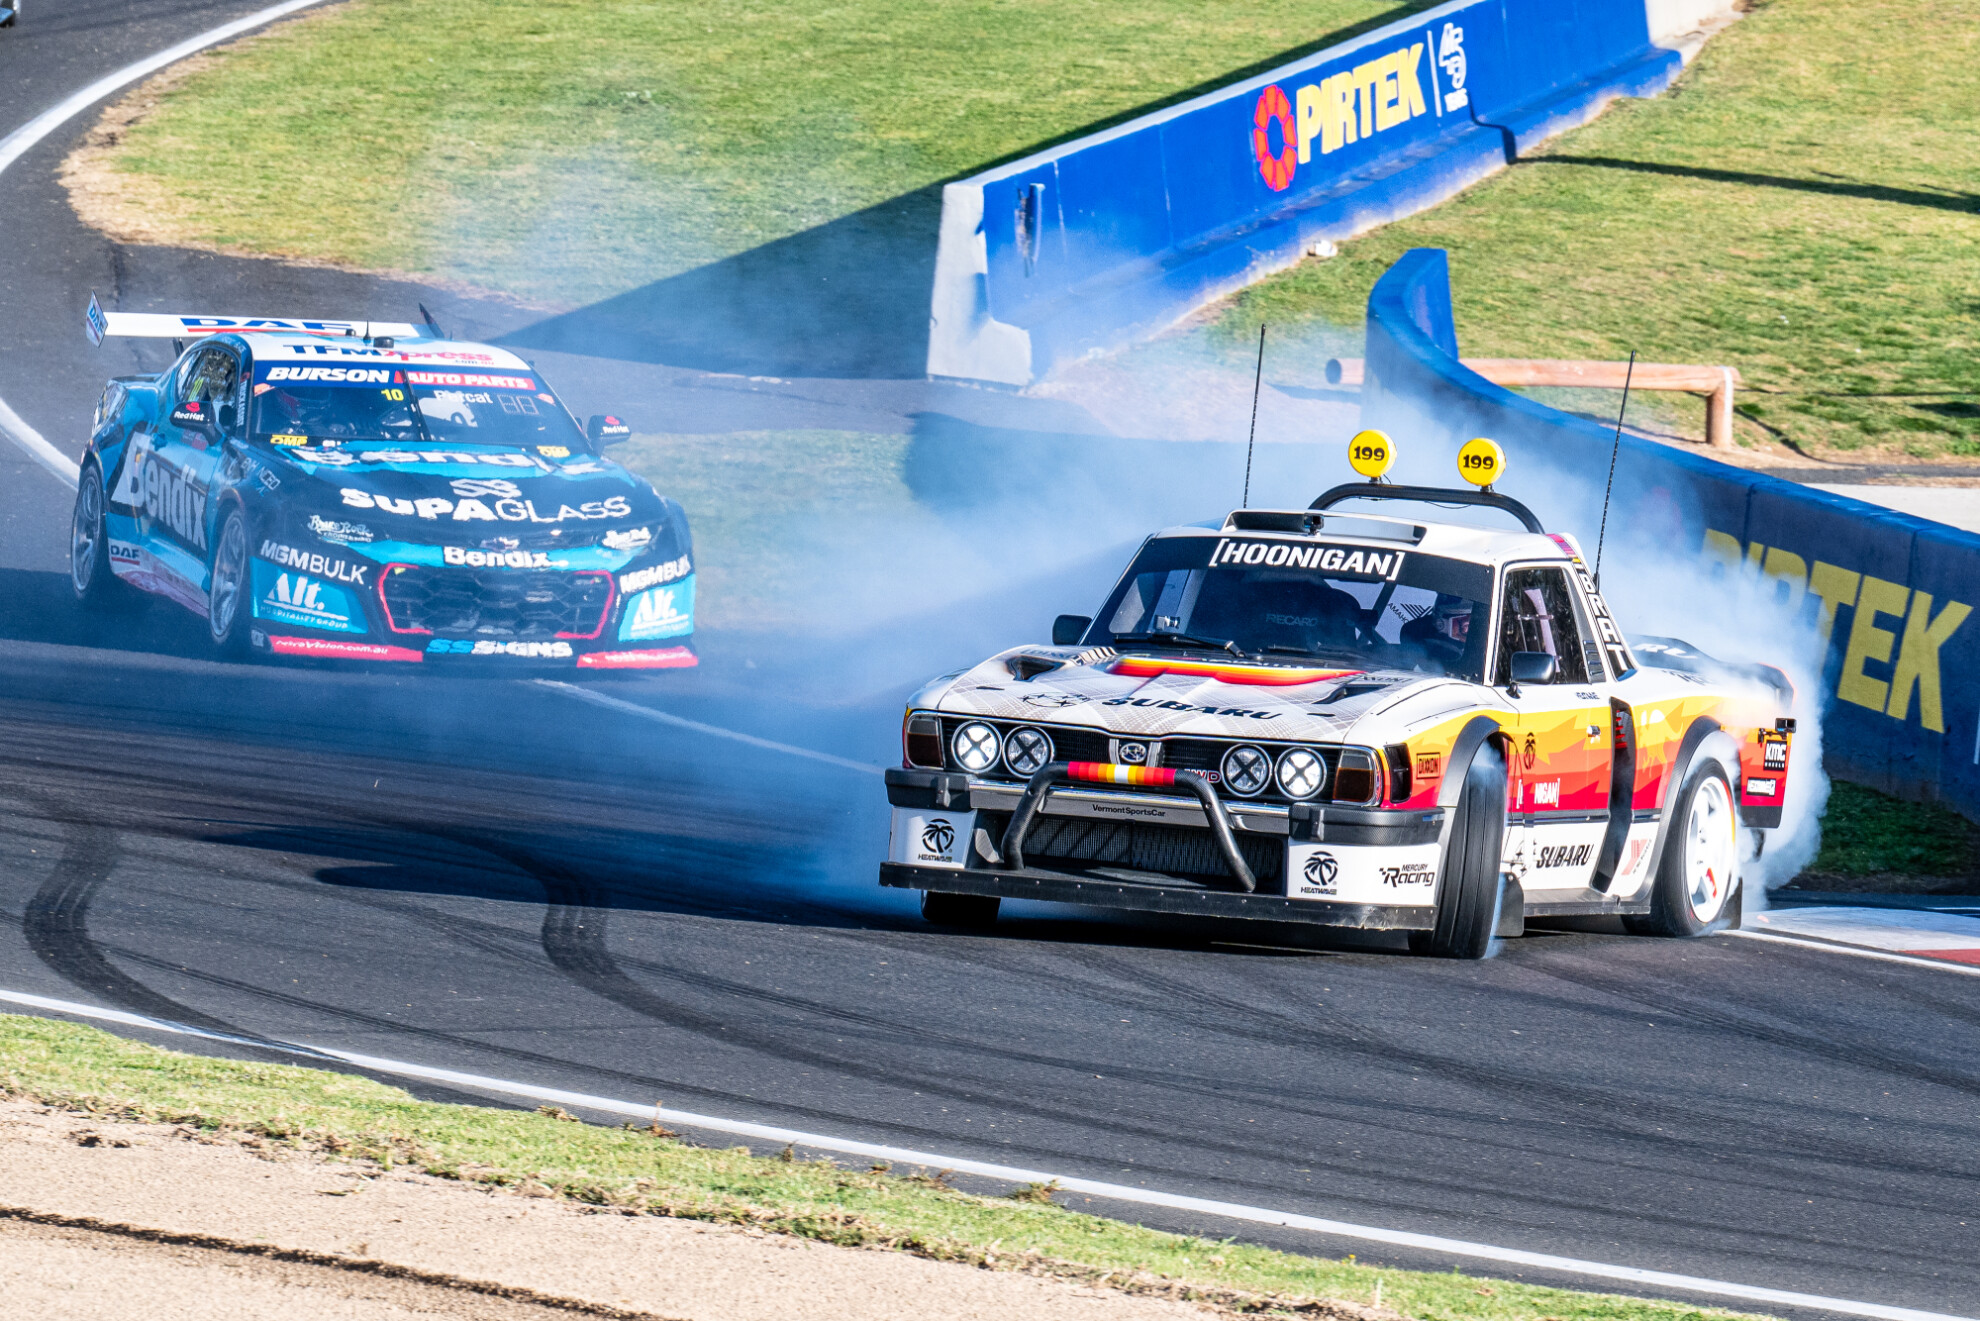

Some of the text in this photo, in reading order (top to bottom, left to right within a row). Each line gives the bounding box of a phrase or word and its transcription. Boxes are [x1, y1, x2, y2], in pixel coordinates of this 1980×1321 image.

[1296, 43, 1427, 164] PIRTEK
[266, 367, 528, 390] BURSON AUTO PARTS
[381, 388, 405, 402] 10
[1354, 445, 1385, 461] 199
[1463, 454, 1494, 470] 199
[111, 432, 208, 551] Bendix
[340, 487, 632, 524] SUPAGLASS
[110, 545, 140, 559] DAF
[260, 539, 368, 585] MGMBULK
[443, 546, 550, 569] Bendix
[1579, 573, 1629, 672] BRAT
[1102, 697, 1282, 720] SUBARU
[1401, 863, 1428, 872] MERCURY
[1536, 844, 1594, 869] SUBARU
